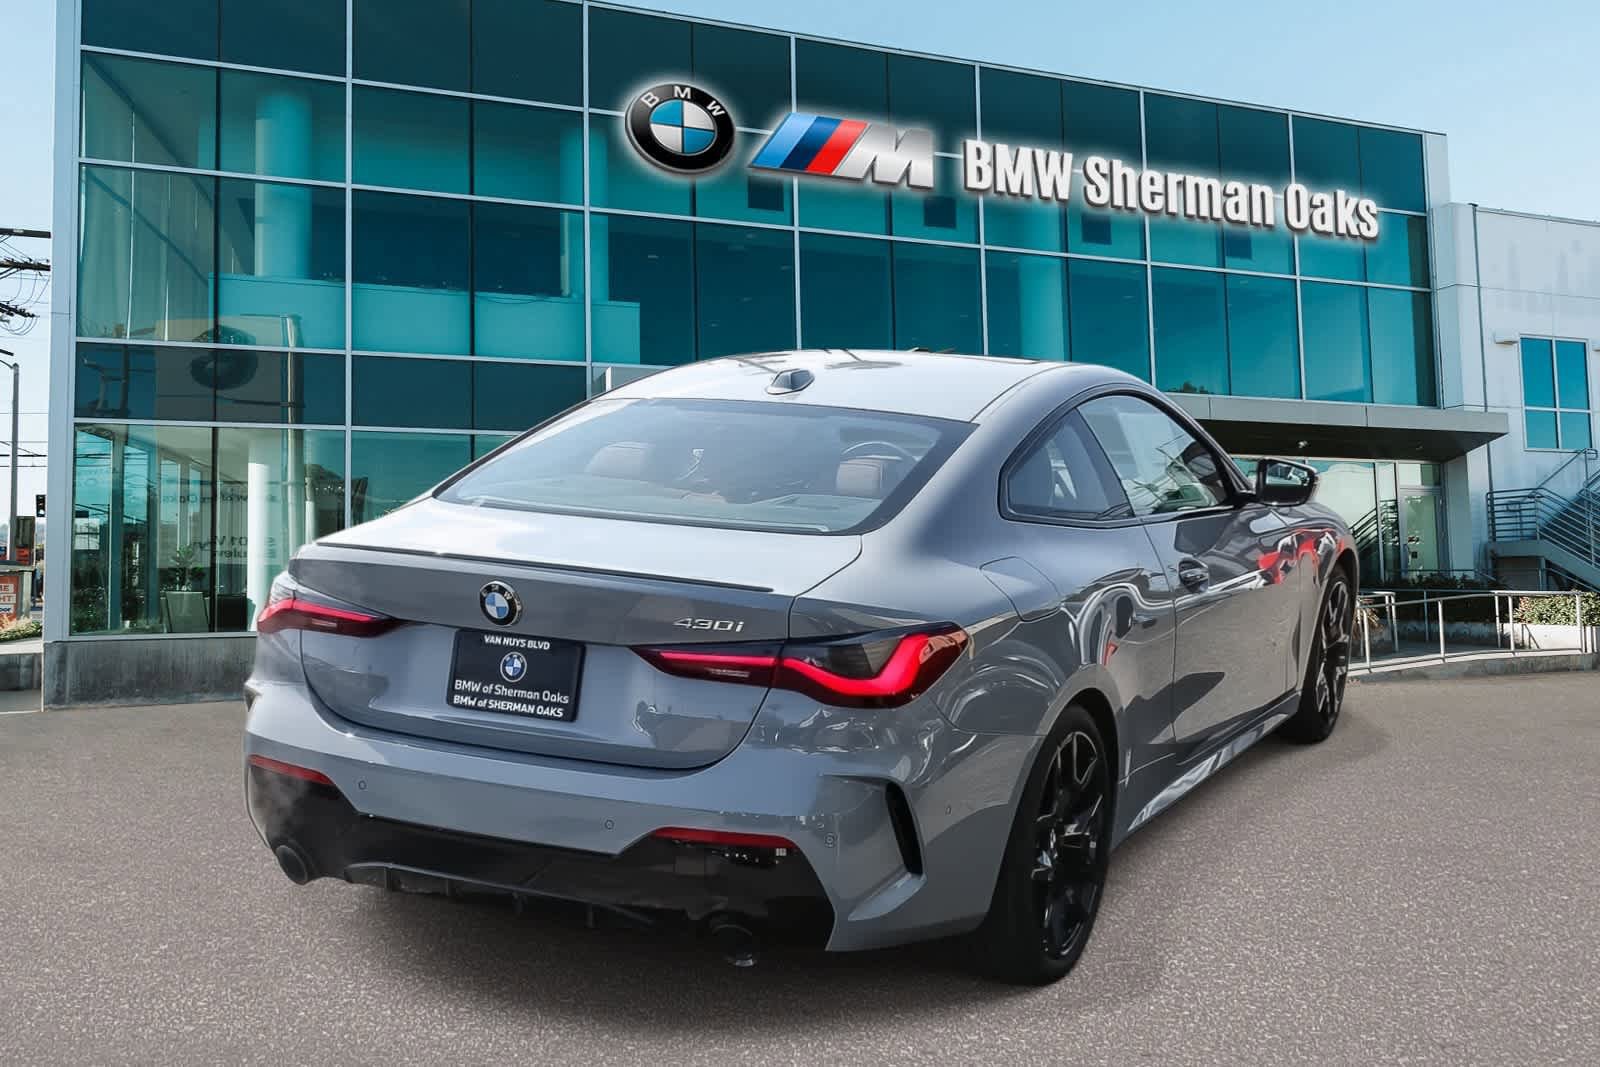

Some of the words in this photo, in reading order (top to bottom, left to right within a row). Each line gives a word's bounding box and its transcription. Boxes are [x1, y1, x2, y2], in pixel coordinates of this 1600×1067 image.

[641, 85, 726, 117] BMW
[963, 139, 1073, 203] BMW
[1083, 155, 1276, 228] Sherman
[1284, 183, 1379, 240] Oaks
[673, 618, 745, 632] 430i
[484, 634, 502, 645] VAN
[502, 637, 527, 648] NUYS
[527, 640, 551, 650] BLVD
[454, 679, 481, 693] BMW
[482, 684, 494, 694] of
[494, 685, 540, 700] Sherman
[542, 690, 569, 704] Oaks
[453, 695, 478, 706] BMW
[477, 699, 487, 708] of
[488, 699, 535, 715] SHERMAN
[536, 705, 564, 718] OAKS
